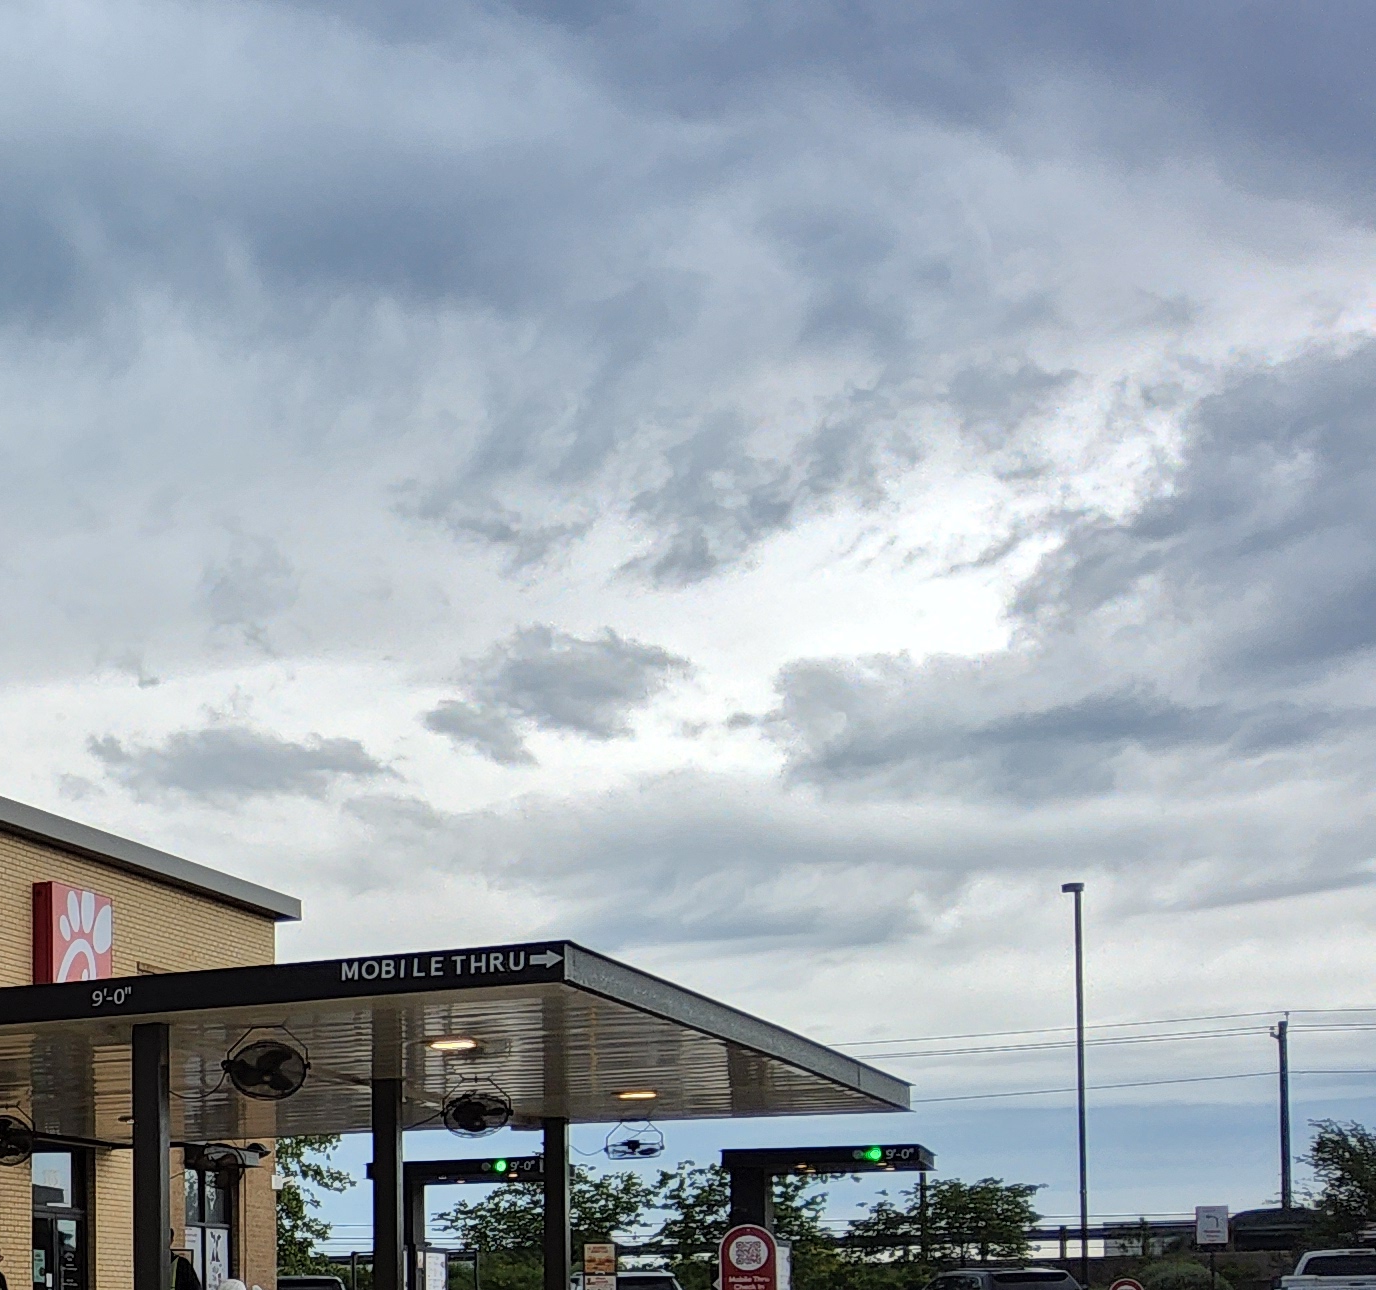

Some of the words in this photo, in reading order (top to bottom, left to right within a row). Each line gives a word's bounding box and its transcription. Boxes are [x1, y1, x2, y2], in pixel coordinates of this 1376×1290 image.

[341, 956, 445, 981] MOBILE
[451, 951, 525, 975] THRU
[91, 986, 132, 1007] 9'-0"
